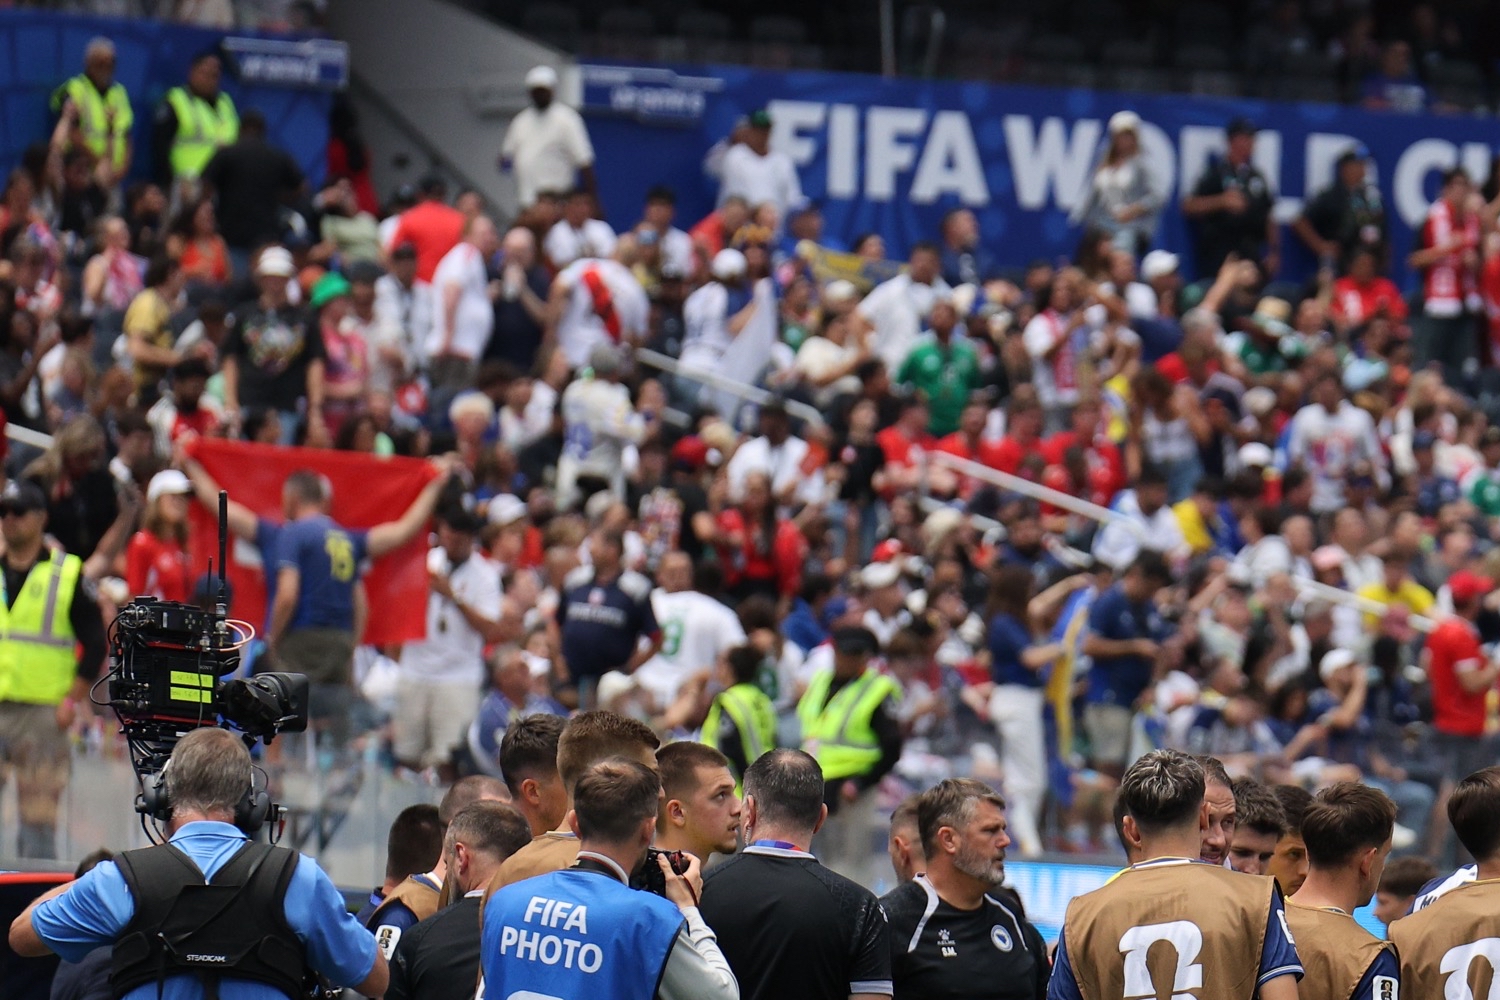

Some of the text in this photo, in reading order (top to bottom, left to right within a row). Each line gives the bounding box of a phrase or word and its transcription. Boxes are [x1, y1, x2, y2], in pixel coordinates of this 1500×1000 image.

[768, 100, 990, 208] FIFA
[524, 896, 587, 935] FIFA
[501, 925, 603, 974] PHOTO
